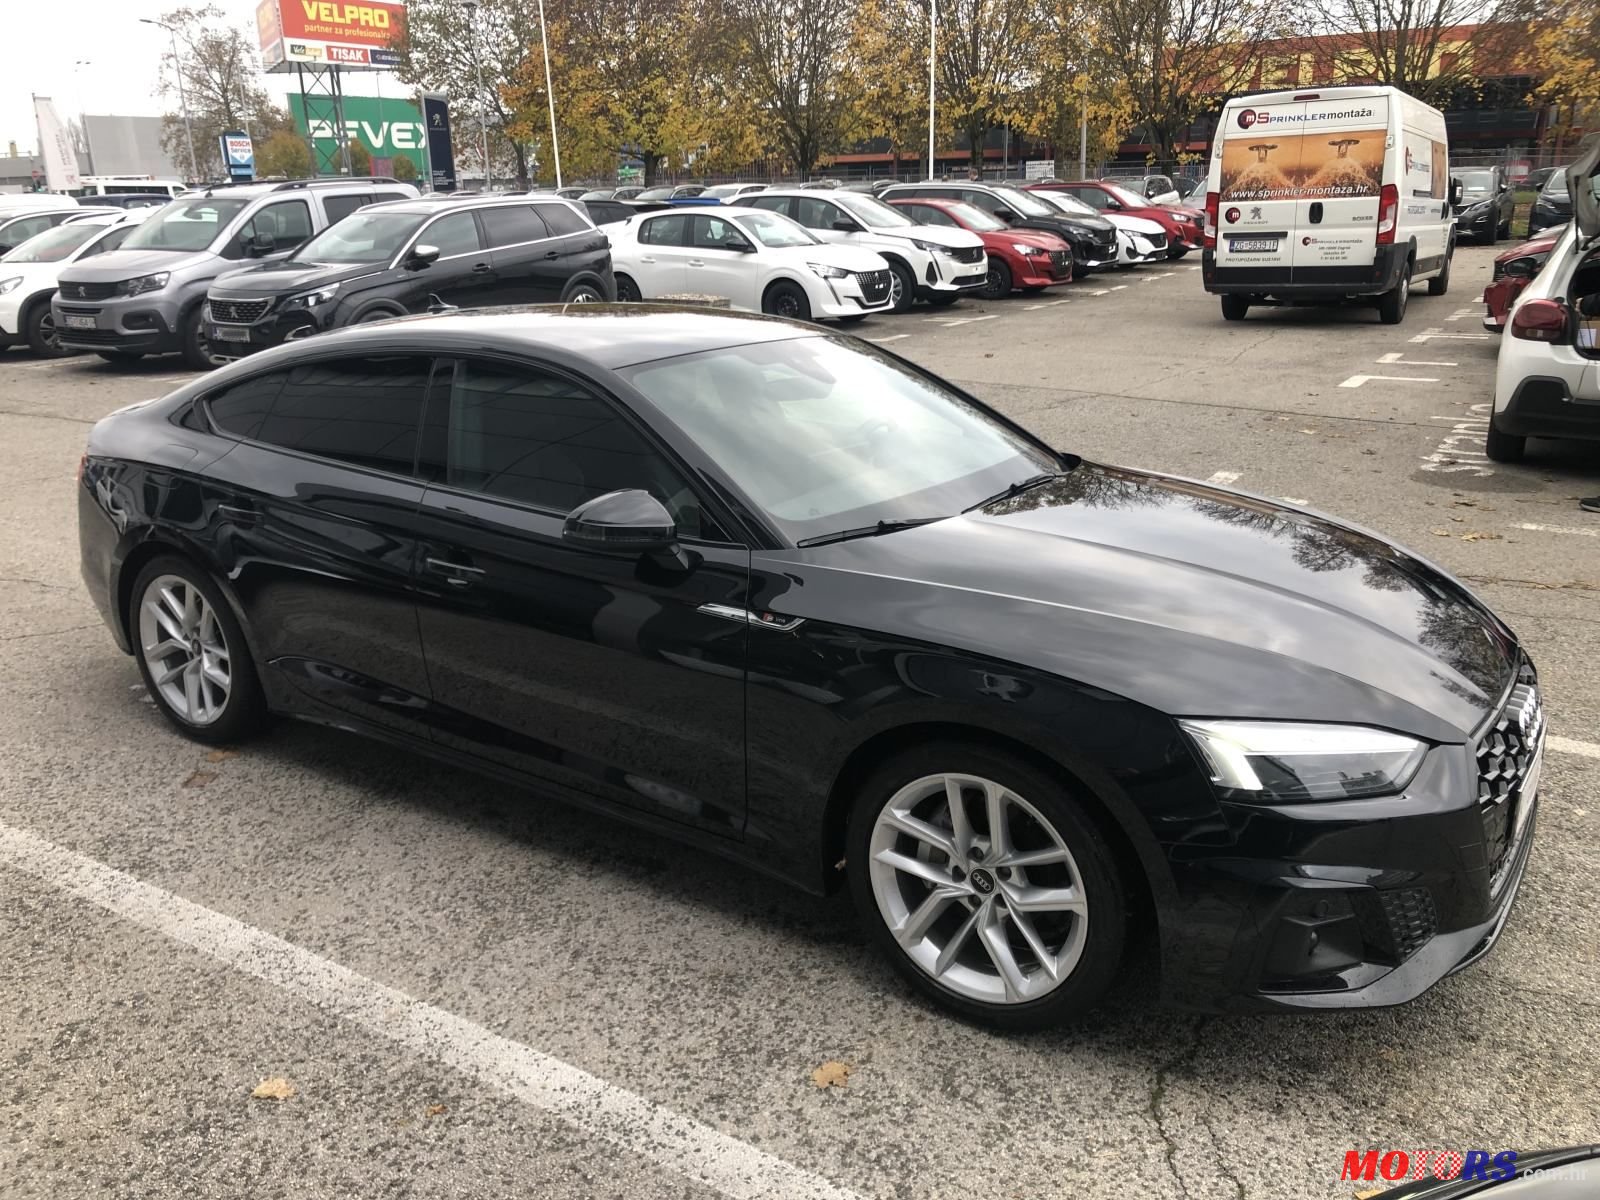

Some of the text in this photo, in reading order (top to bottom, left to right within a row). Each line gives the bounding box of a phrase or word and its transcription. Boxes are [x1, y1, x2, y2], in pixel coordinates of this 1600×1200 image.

[302, 1, 389, 28] VELPRO
[304, 24, 332, 33] partner
[330, 48, 363, 61] TISAK
[1231, 184, 1369, 199] www.sprinkler-montaza.hr
